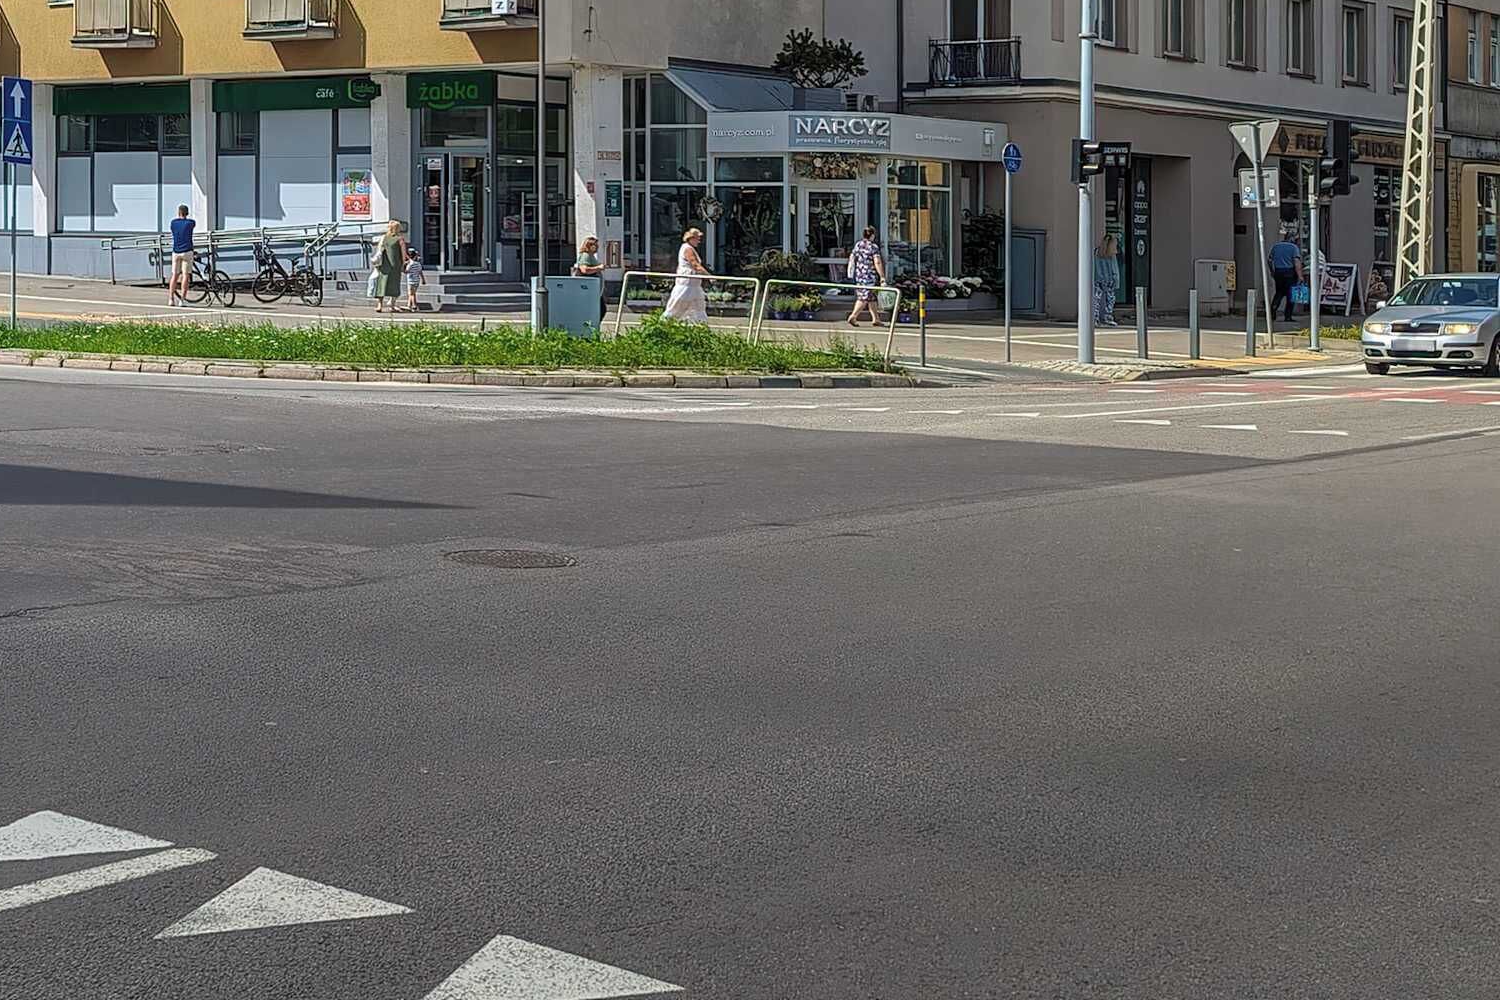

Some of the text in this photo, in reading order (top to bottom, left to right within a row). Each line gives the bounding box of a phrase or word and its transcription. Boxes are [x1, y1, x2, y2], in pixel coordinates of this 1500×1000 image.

[315, 88, 335, 99] café
[418, 82, 479, 101] żabka
[795, 117, 891, 137] NARCYZ
